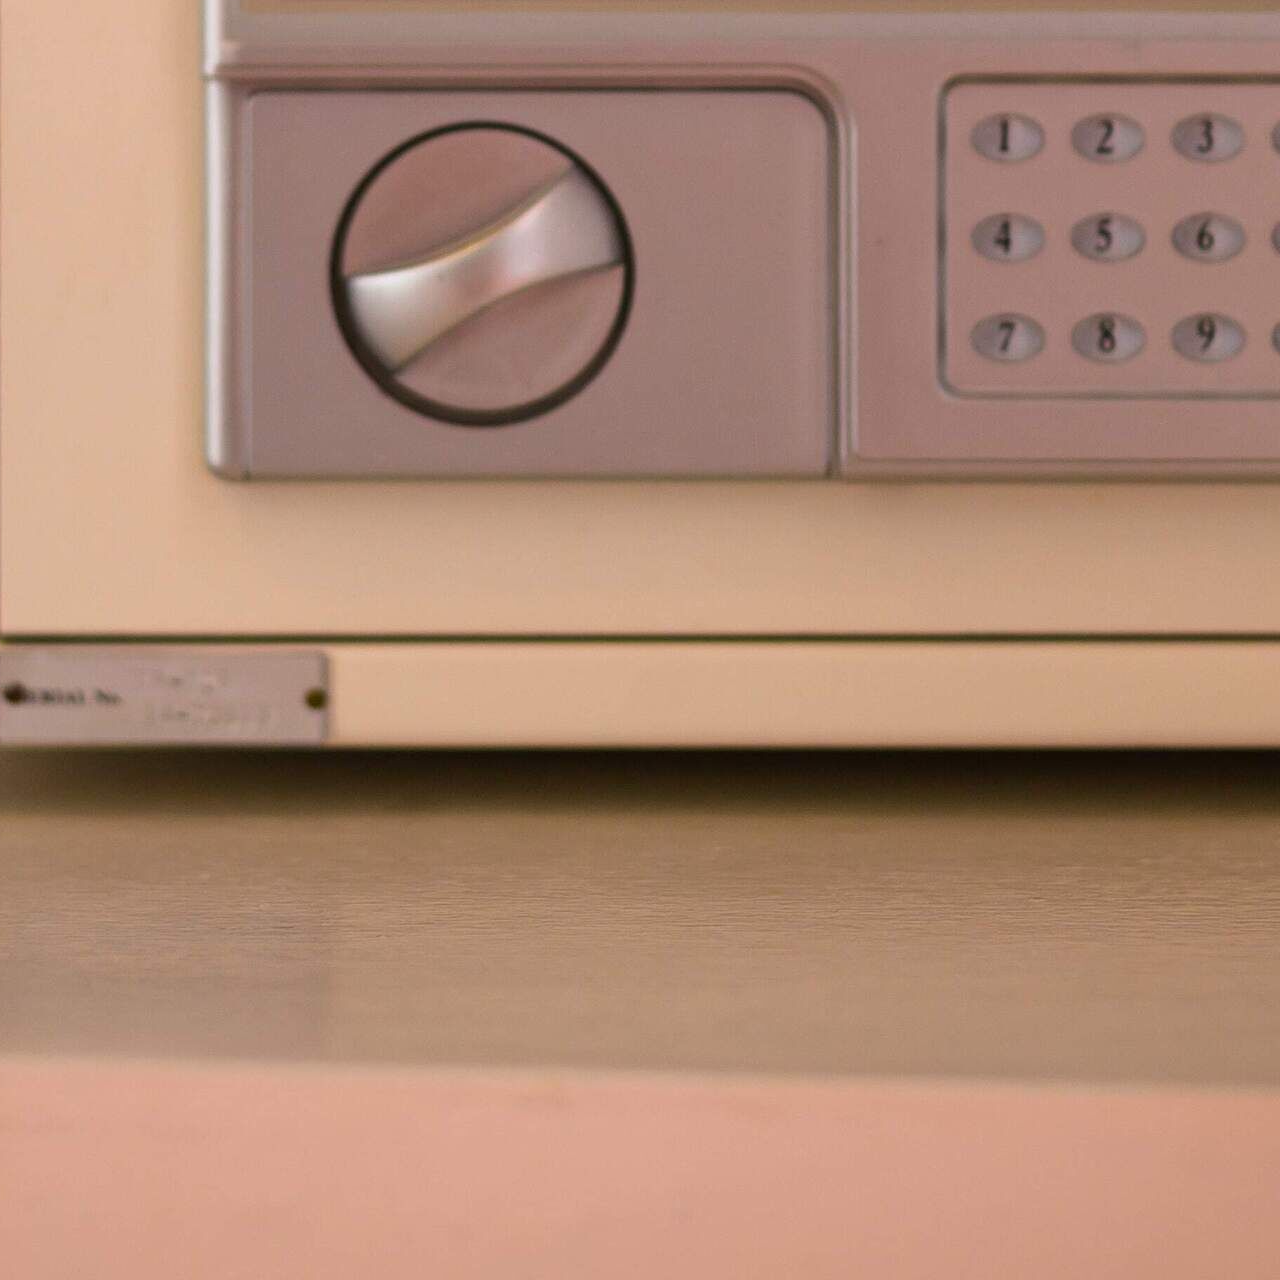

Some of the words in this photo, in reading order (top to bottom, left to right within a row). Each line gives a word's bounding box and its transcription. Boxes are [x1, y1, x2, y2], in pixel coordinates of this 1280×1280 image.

[997, 119, 1010, 154] 1
[1097, 120, 1115, 155] 2
[1196, 120, 1215, 154] 3
[993, 220, 1012, 254] 4
[1094, 220, 1113, 253] 5
[1196, 220, 1215, 253] 6
[998, 322, 1016, 353] 7
[1097, 320, 1116, 353] 8
[1196, 319, 1216, 350] 9
